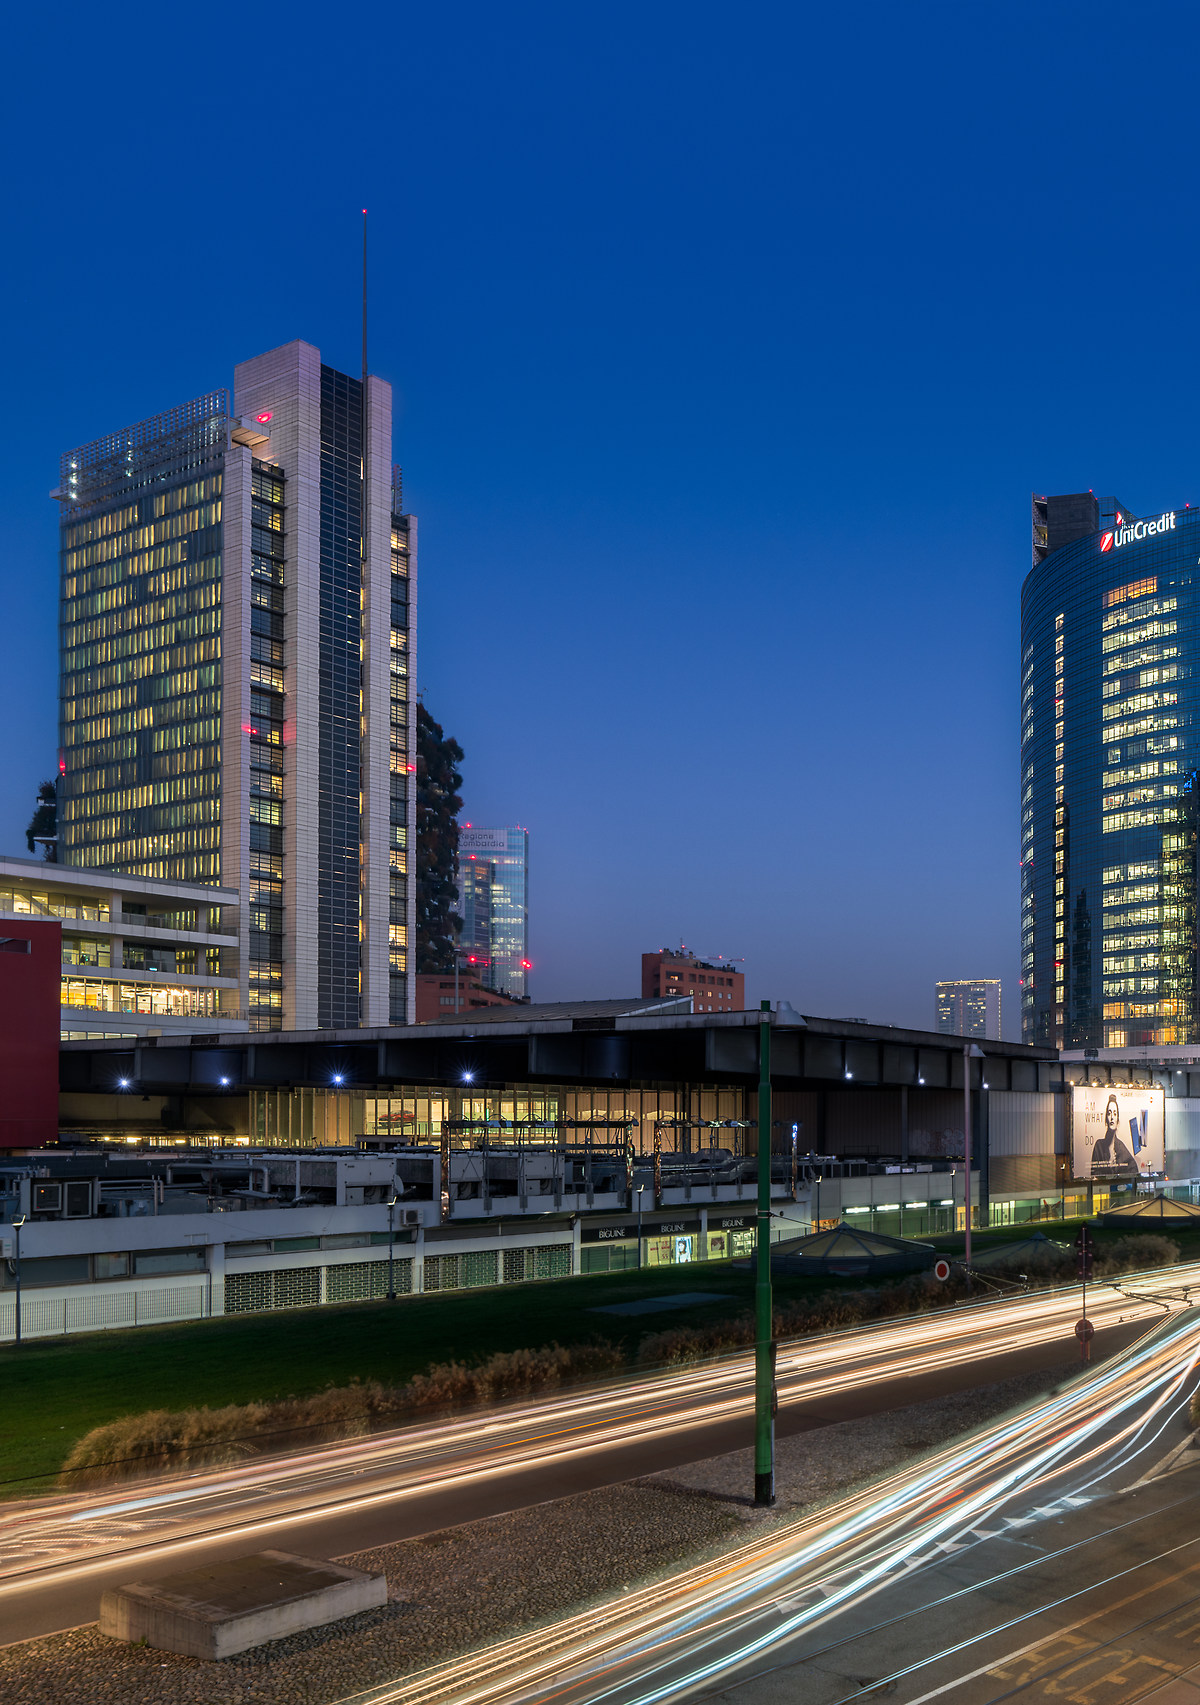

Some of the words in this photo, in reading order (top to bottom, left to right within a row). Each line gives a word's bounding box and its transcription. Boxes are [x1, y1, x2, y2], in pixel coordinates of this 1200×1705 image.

[1114, 511, 1176, 547] UniCredit
[1085, 1113, 1104, 1123] WHAT
[1085, 1135, 1094, 1146] DO
[661, 1224, 685, 1233] BIGUINE
[599, 1229, 625, 1239] BIGUINE
